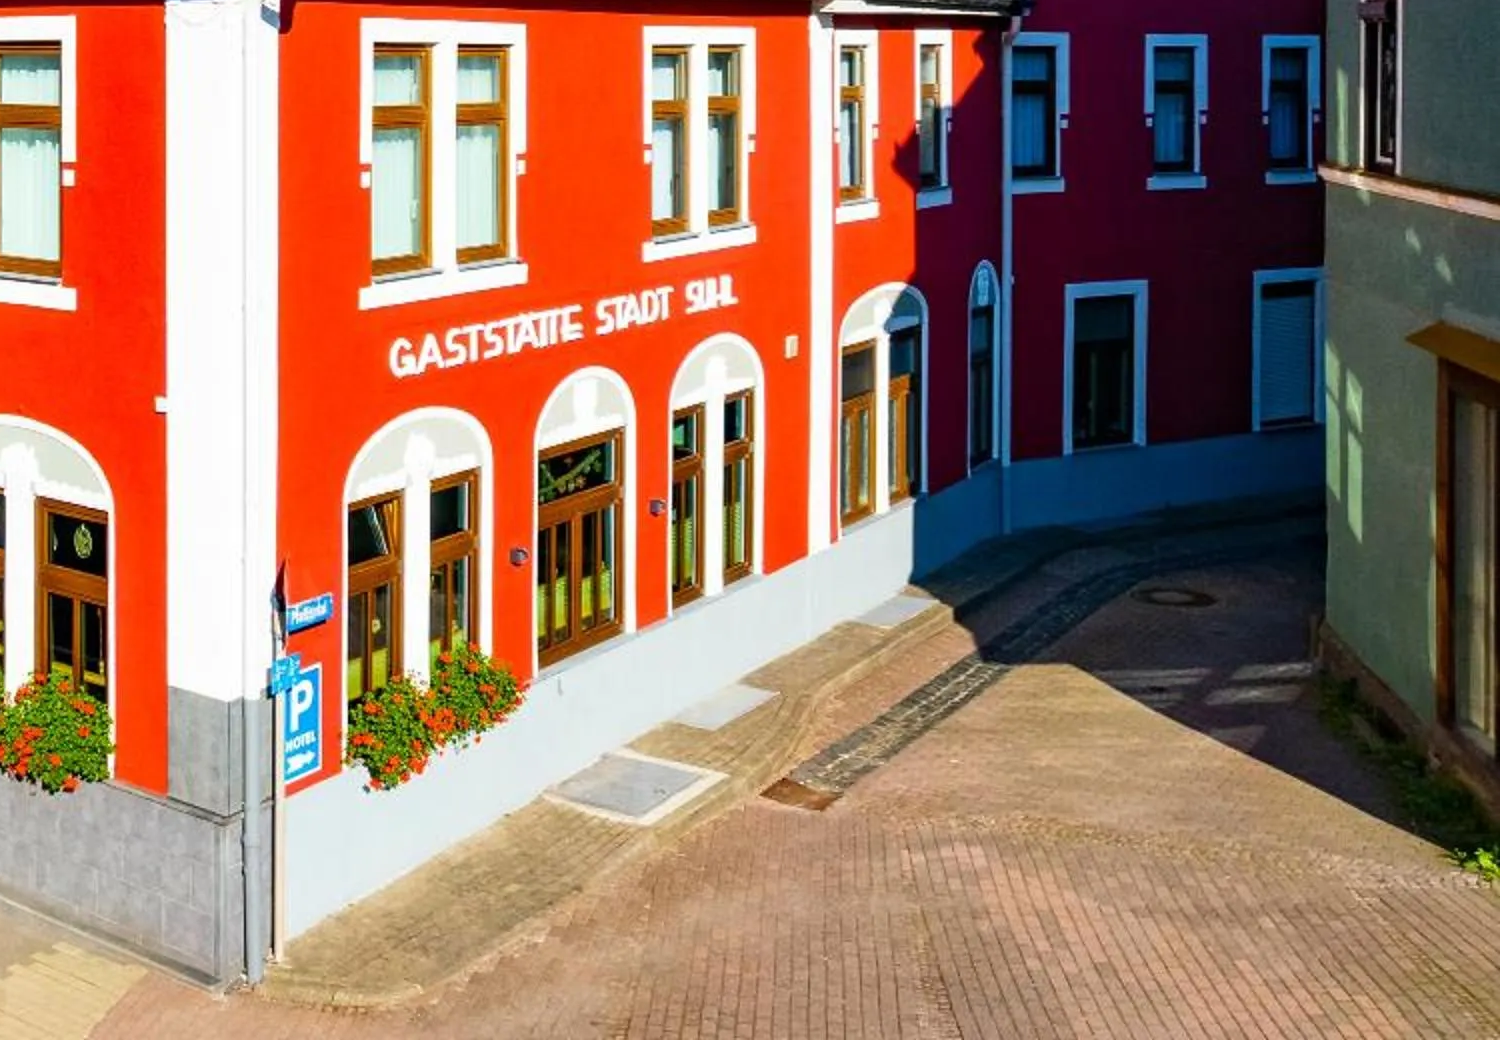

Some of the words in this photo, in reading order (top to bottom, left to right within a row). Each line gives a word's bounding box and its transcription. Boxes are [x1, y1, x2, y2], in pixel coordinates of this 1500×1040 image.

[596, 286, 675, 336] STADT
[685, 274, 739, 315] SUHL
[290, 679, 314, 733] P
[285, 730, 317, 753] HOTEL
